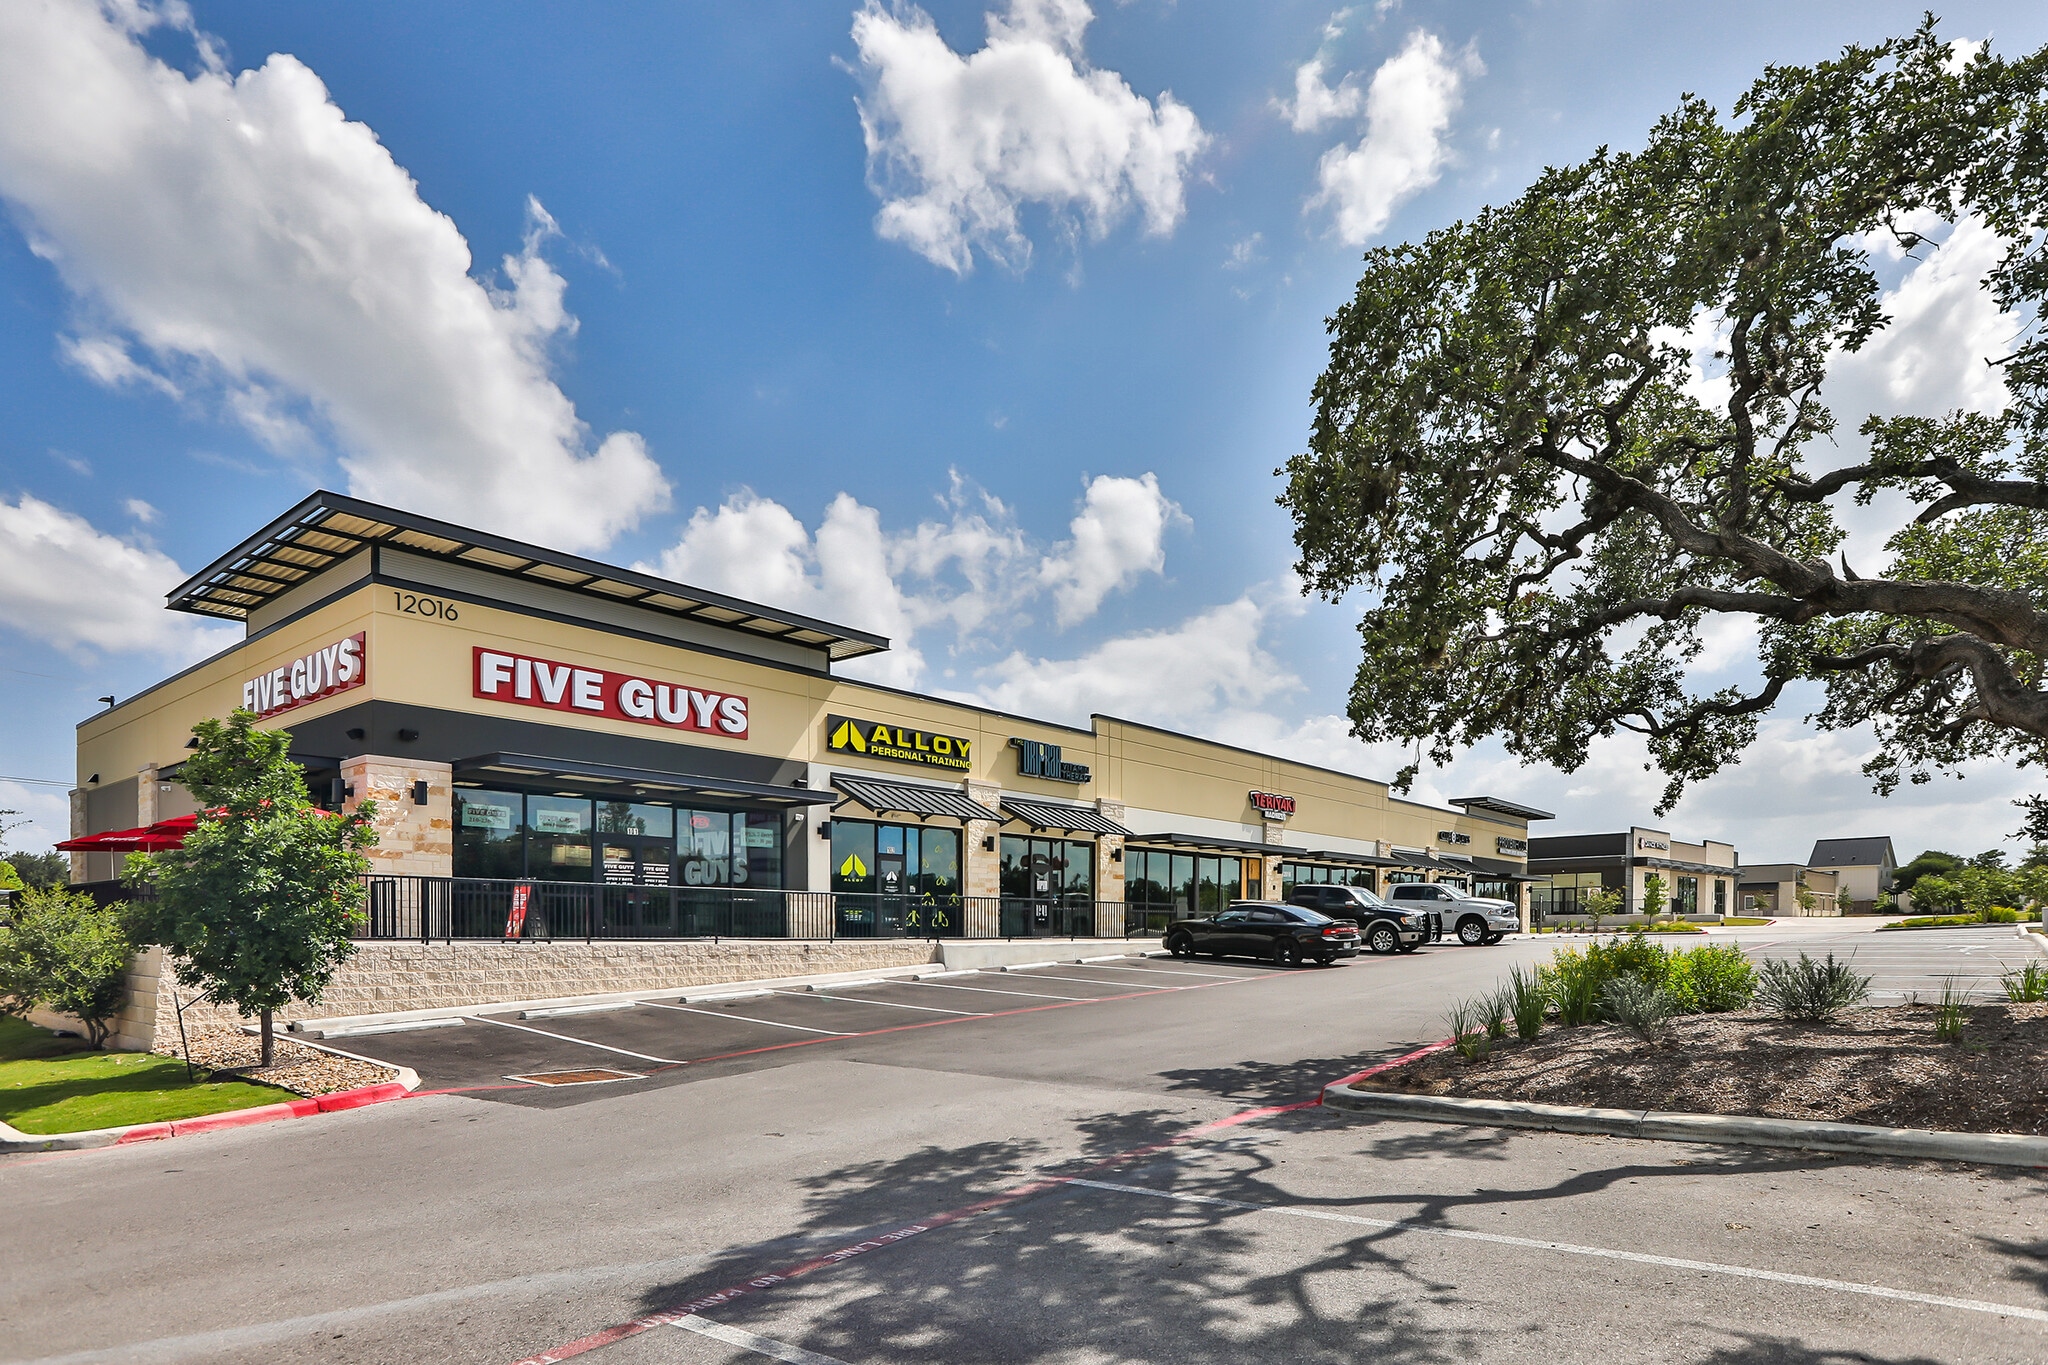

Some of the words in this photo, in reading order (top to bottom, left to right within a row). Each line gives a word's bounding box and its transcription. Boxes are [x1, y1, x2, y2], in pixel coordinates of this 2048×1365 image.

[393, 591, 459, 622] 12016
[243, 666, 293, 714] FIVE
[290, 637, 361, 701] GUYS
[479, 651, 605, 711] FIVE
[617, 678, 748, 734] GUYS
[870, 724, 973, 758] ALLOY
[871, 745, 924, 762] PERSONAL
[925, 753, 973, 769] TRAINING
[1254, 793, 1297, 814] TERIYAKI
[694, 830, 742, 857] FIVE
[684, 857, 748, 886] GUYS
[879, 1224, 928, 1242] FIRE
[822, 1240, 883, 1263] LANE
[750, 1273, 786, 1290] NO
